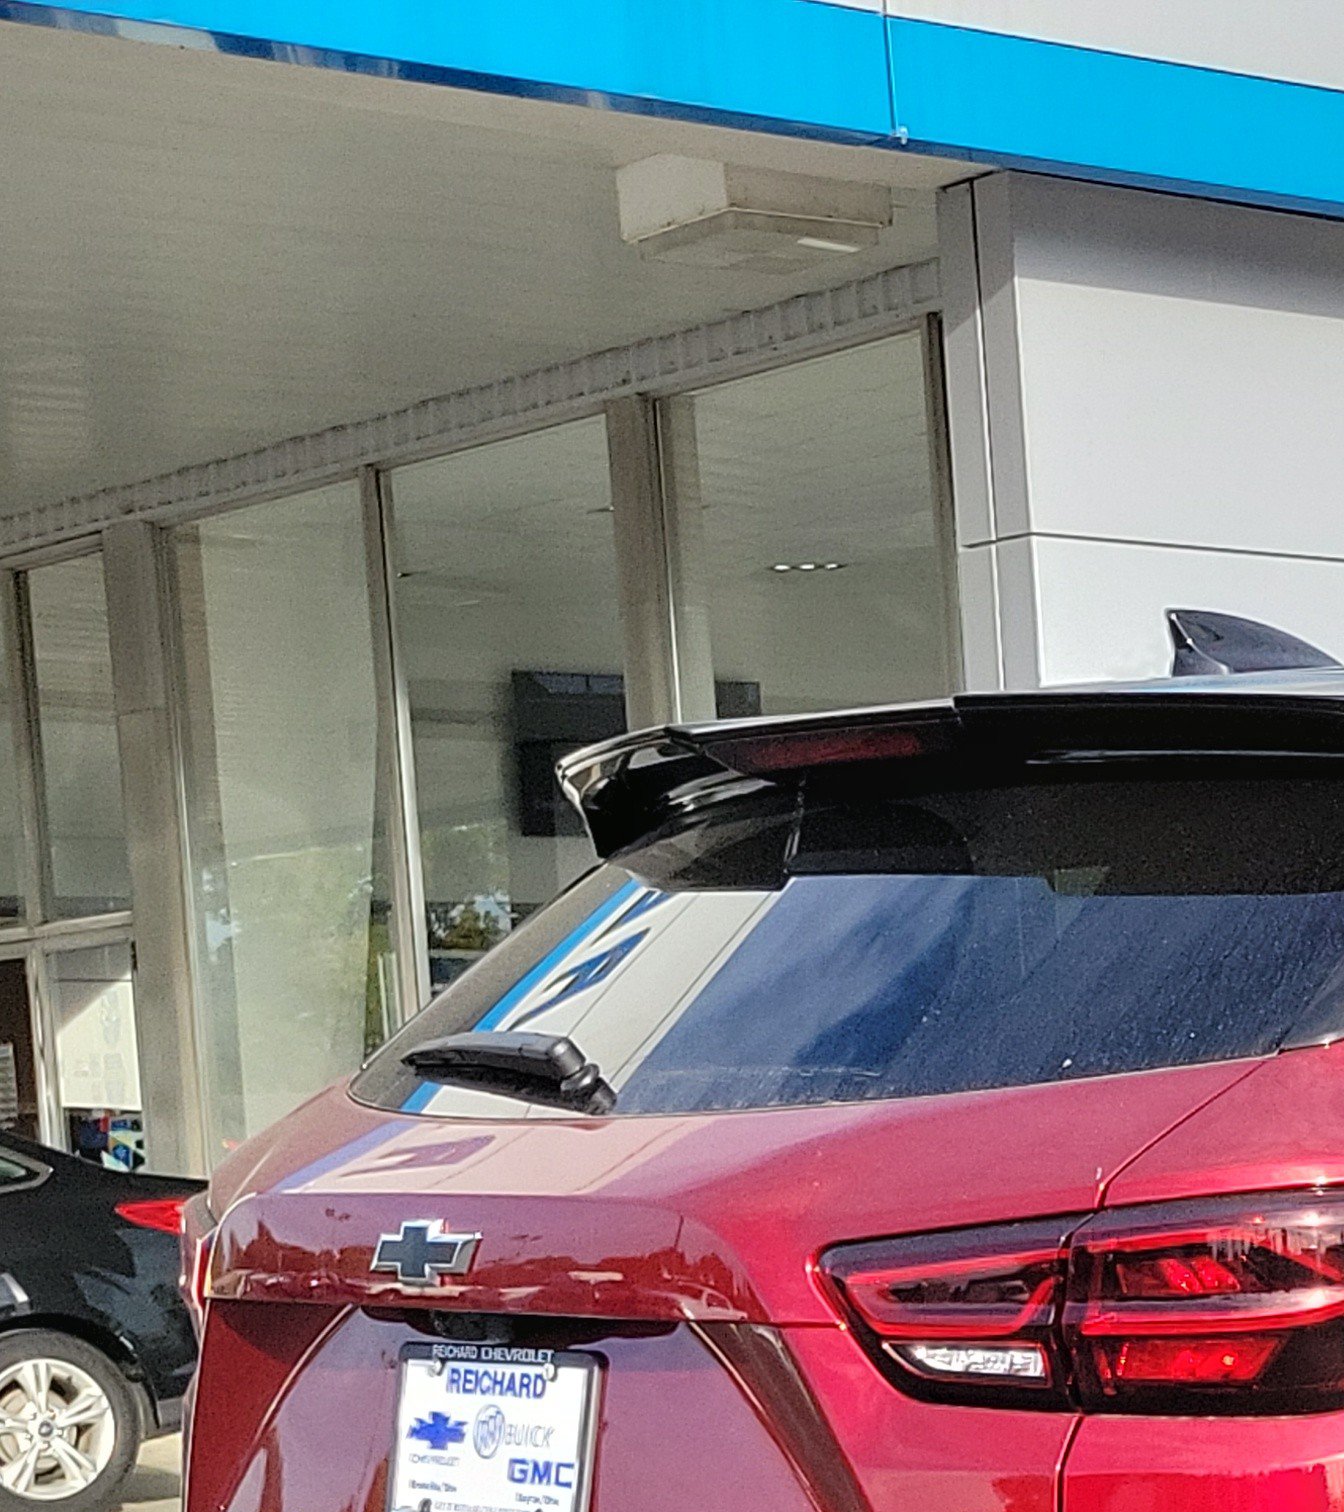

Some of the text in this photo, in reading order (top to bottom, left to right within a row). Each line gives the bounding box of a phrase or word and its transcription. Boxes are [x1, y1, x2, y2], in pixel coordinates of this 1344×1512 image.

[432, 1344, 554, 1363] REICHARD CHEVROLET
[446, 1367, 547, 1399] REICHARD
[505, 1424, 555, 1448] BUICK
[507, 1457, 575, 1489] GMC
